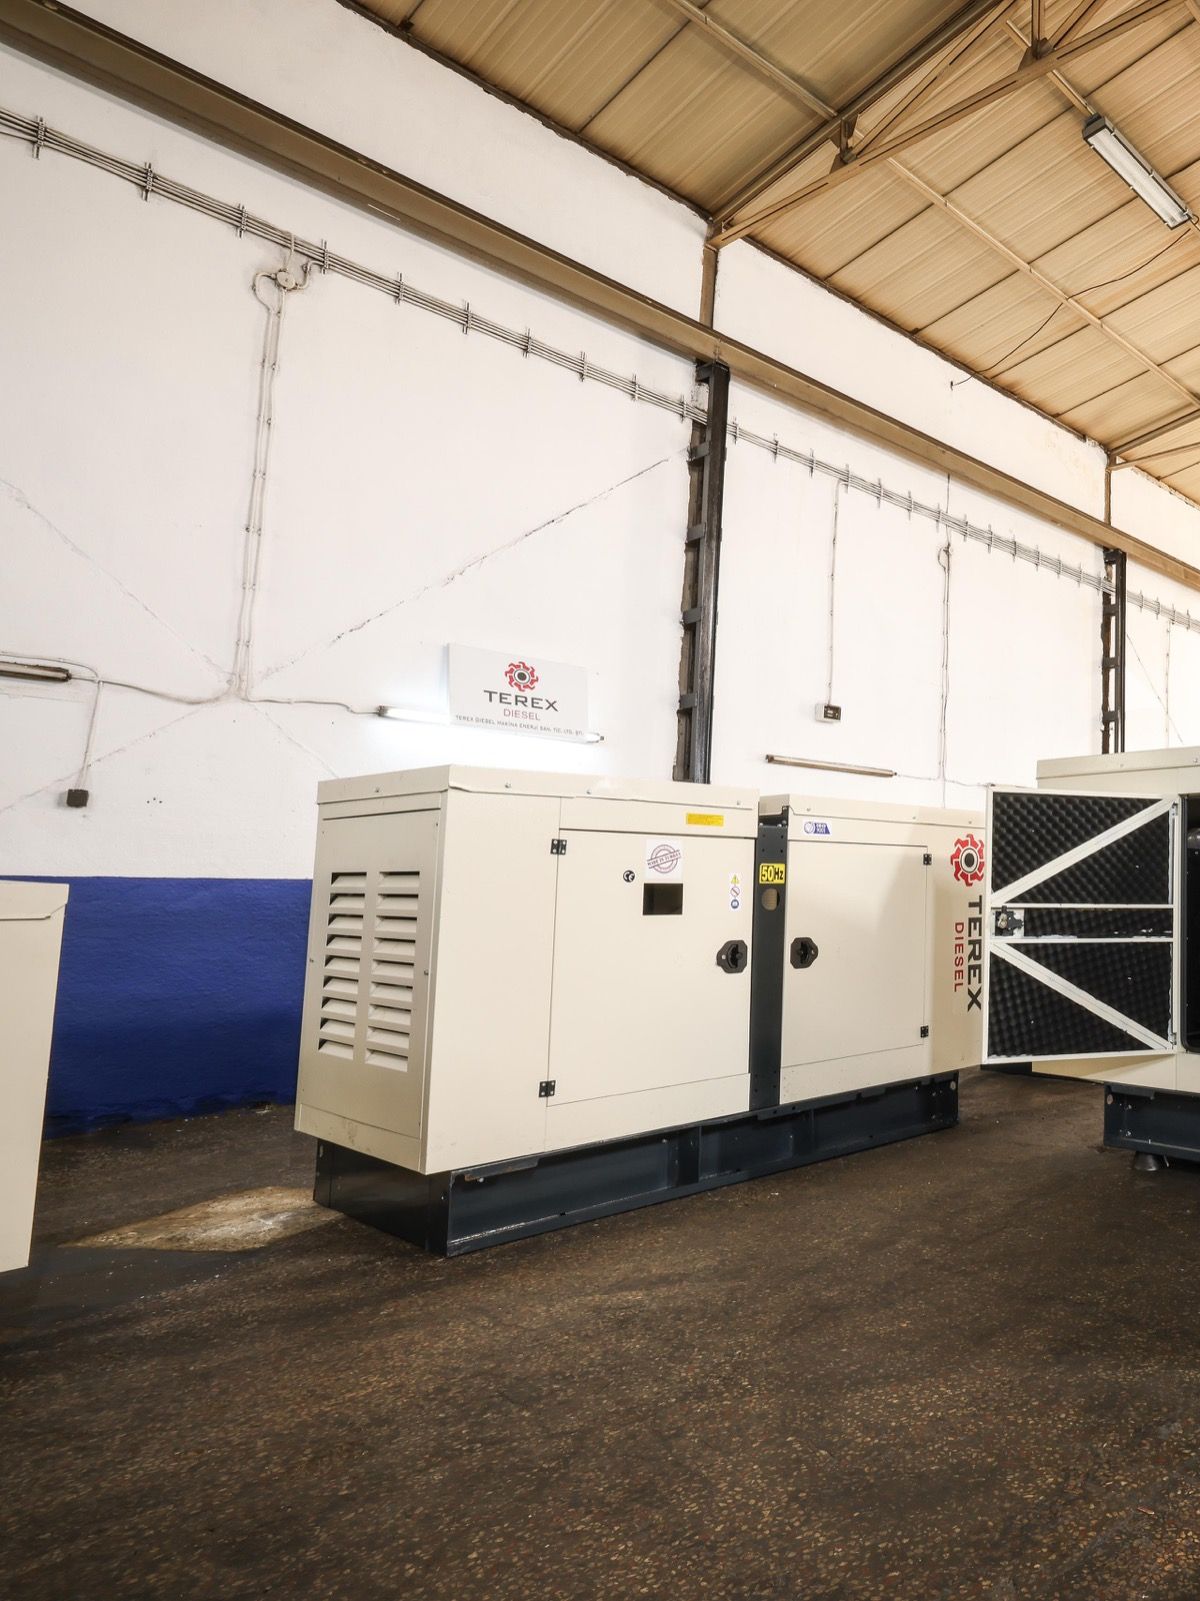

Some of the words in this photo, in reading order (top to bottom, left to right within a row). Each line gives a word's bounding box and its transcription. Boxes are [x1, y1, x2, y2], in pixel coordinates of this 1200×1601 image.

[483, 689, 559, 712] TEREX
[503, 708, 541, 721] DIESEL
[761, 865, 784, 881] 50Hz
[954, 922, 965, 993] DIESEL
[967, 894, 983, 1012] TEREX
